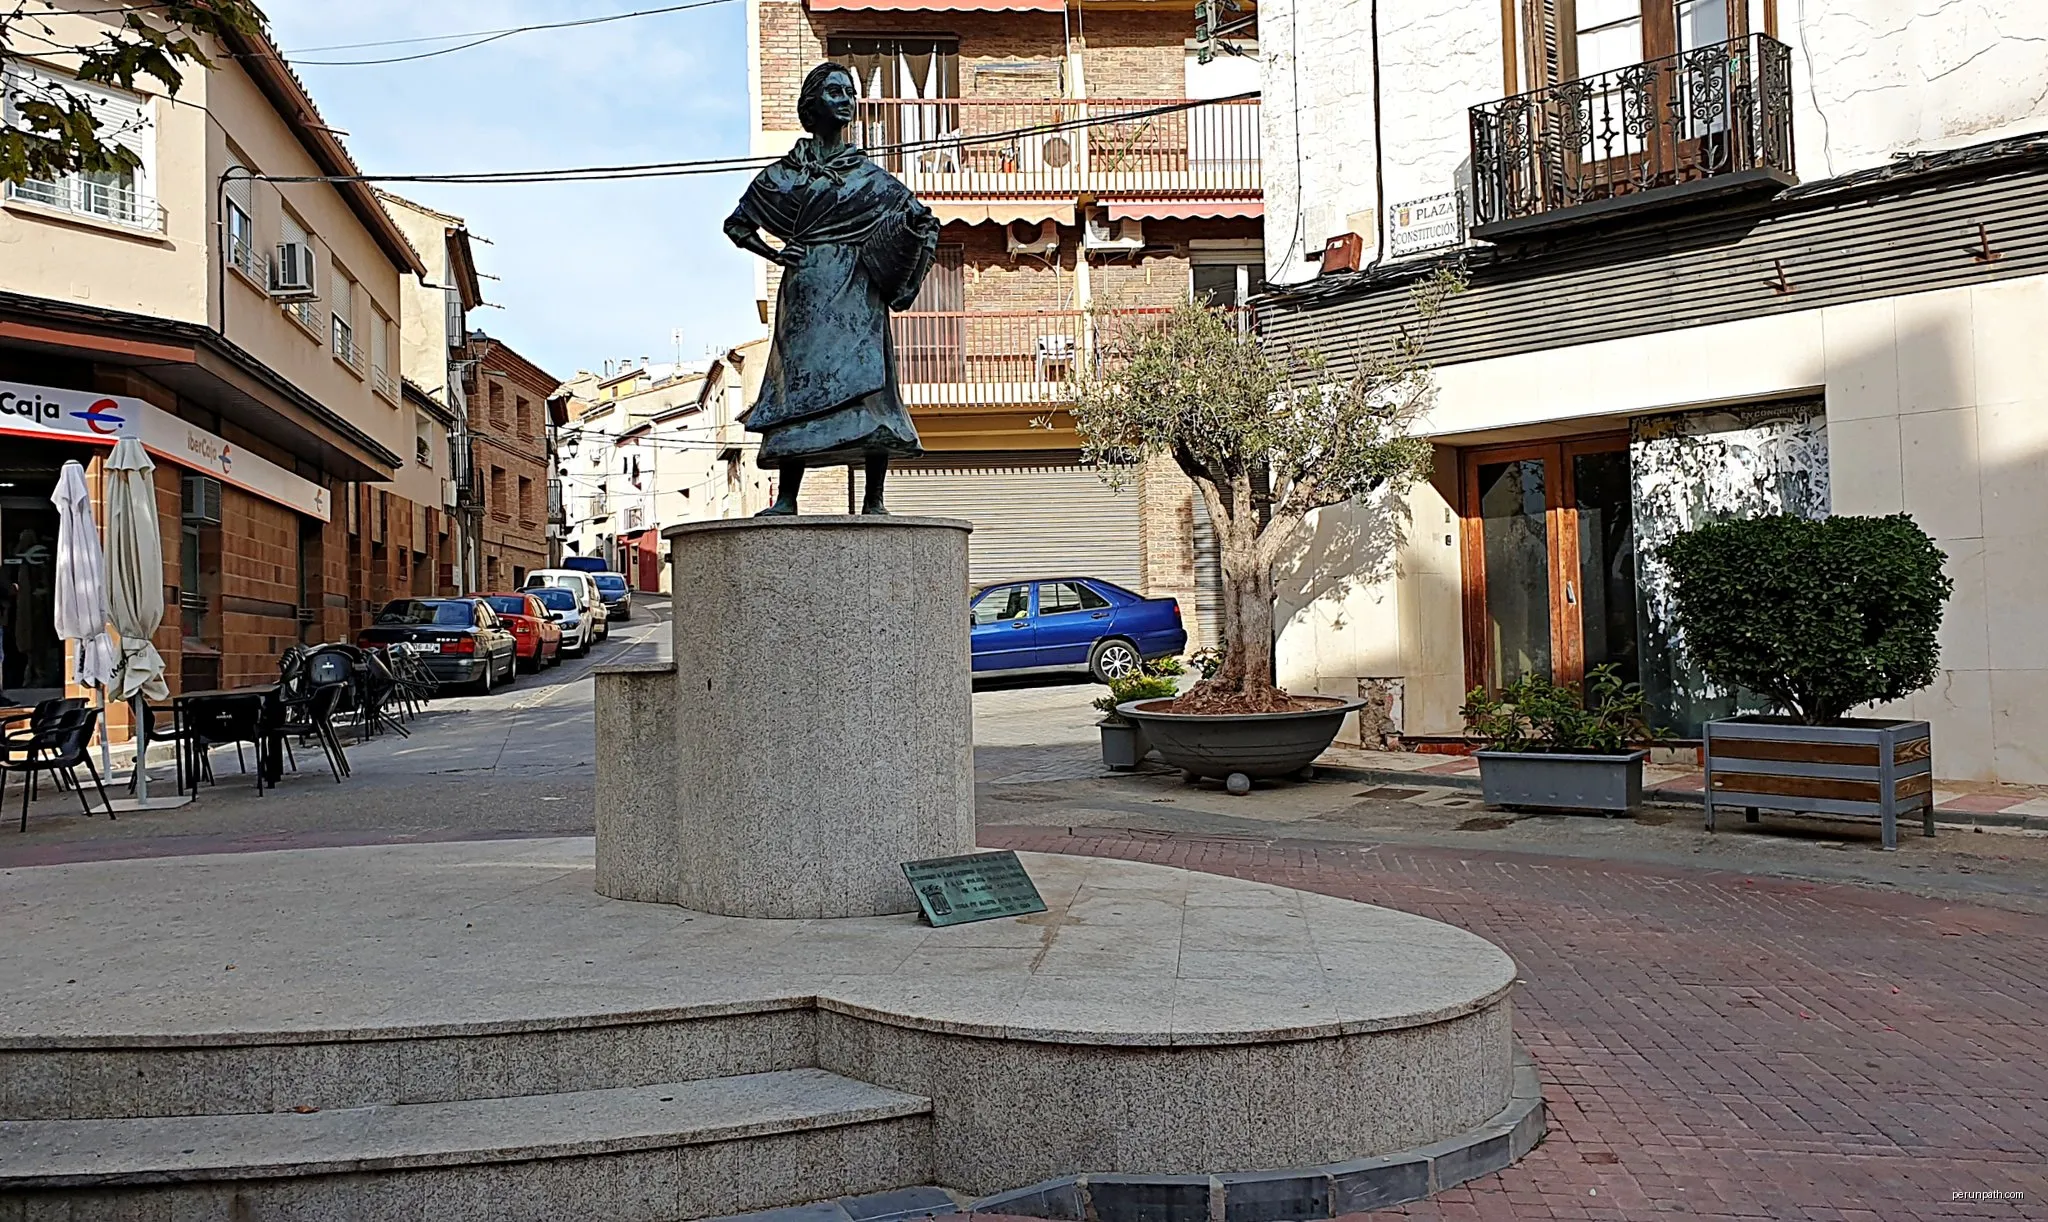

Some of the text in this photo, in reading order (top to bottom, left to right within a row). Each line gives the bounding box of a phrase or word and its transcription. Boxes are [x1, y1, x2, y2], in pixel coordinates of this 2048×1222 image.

[1416, 202, 1454, 220] PLAZA
[1396, 221, 1456, 245] CONSTITUCIÓN
[0, 392, 60, 424] Caja
